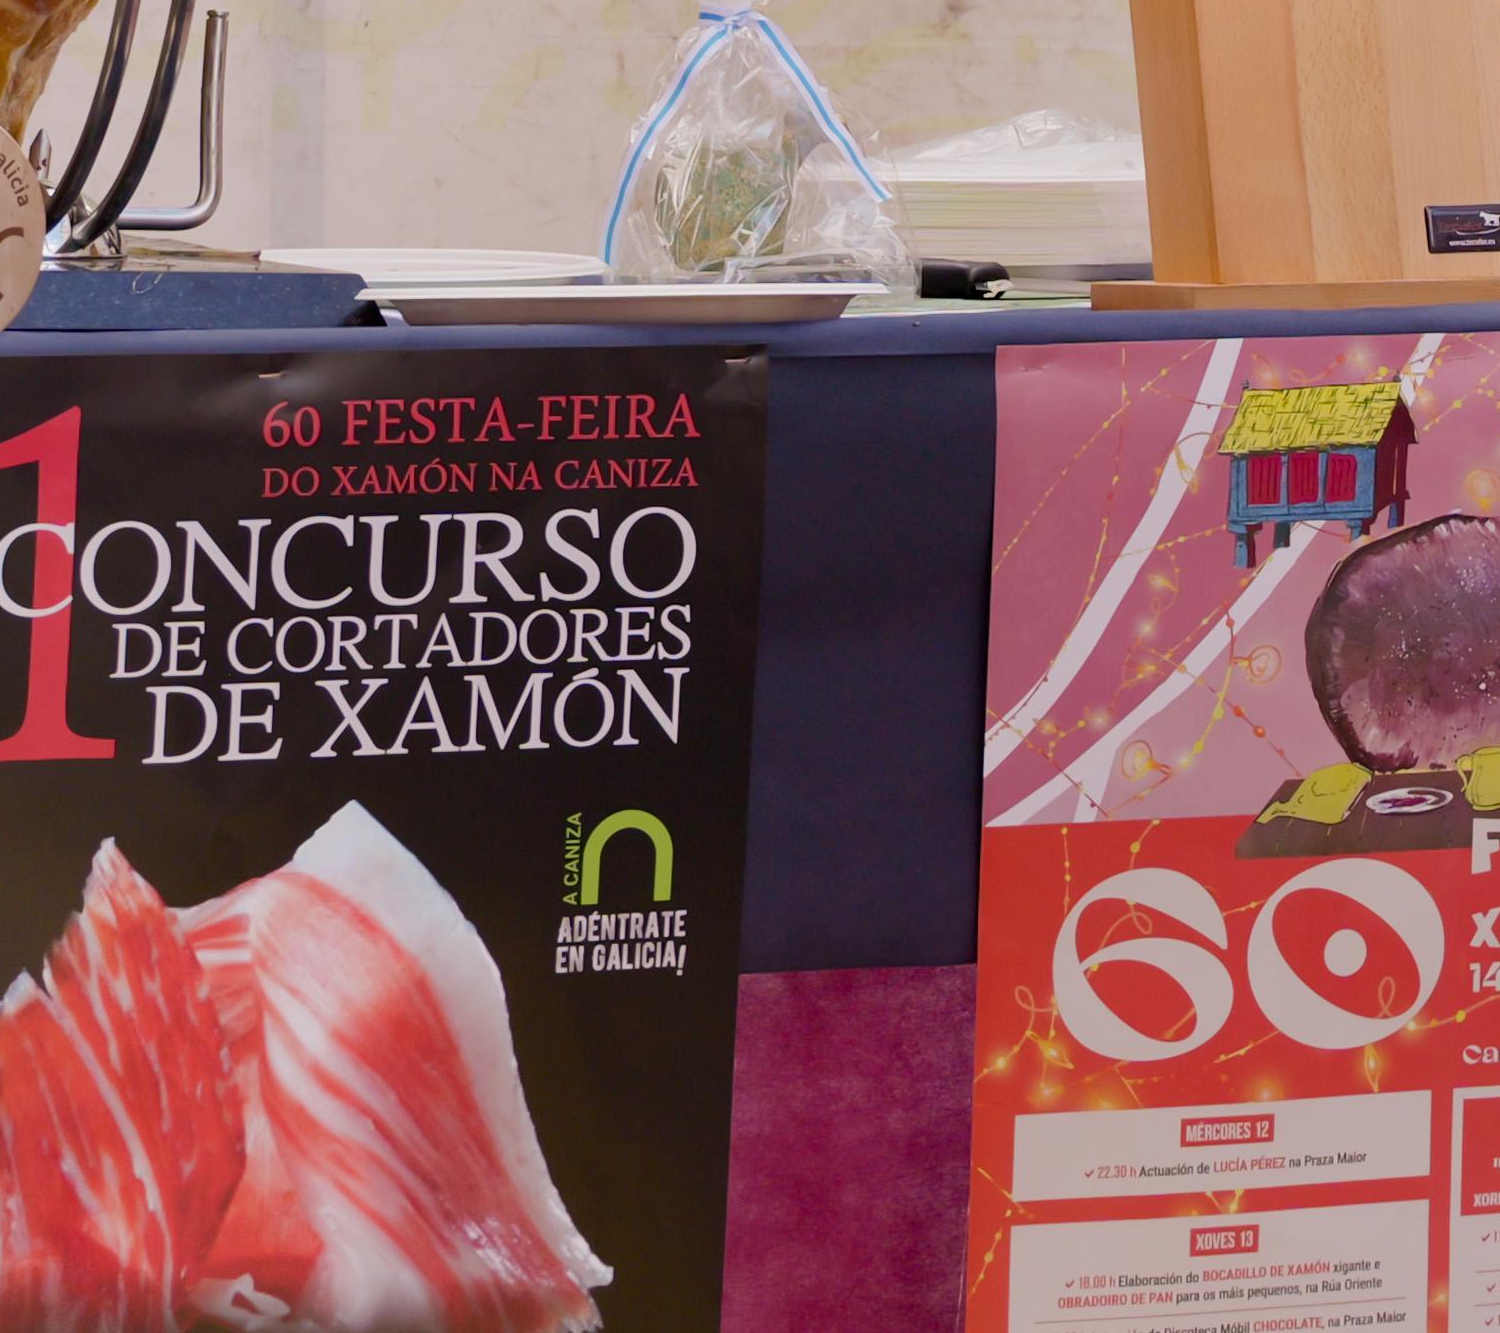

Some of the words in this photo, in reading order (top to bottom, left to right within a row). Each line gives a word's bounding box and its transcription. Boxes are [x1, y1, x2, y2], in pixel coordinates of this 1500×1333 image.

[262, 401, 321, 448] 60
[341, 393, 701, 446] FESTA-FEIRA
[261, 466, 321, 497] DO
[331, 458, 477, 496] XAMÓN
[489, 461, 543, 491] NA
[554, 457, 699, 490] CANIZA
[109, 619, 209, 679] DE
[226, 604, 692, 676] CORTADORES
[141, 681, 284, 765] DE
[310, 666, 690, 759] XAMÓN
[563, 812, 582, 886] CANIZA
[563, 892, 577, 905] A
[557, 910, 687, 943] ADÉNTRATE
[555, 945, 585, 973] EN
[592, 940, 686, 976] GALICIA!
[1052, 857, 1445, 1062] 60
[1186, 1120, 1251, 1142] MÉRCORES
[1256, 1121, 1269, 1138] 12
[1139, 1162, 1194, 1177] Actuación
[1197, 1163, 1210, 1174] de
[1213, 1157, 1248, 1173] LUCÍA
[1250, 1156, 1286, 1170] PÉREZ
[1289, 1157, 1301, 1168] na
[1304, 1155, 1334, 1167] Praza
[1337, 1151, 1367, 1164] Maior
[1196, 1231, 1235, 1251] XOVES
[1240, 1230, 1253, 1248] 13
